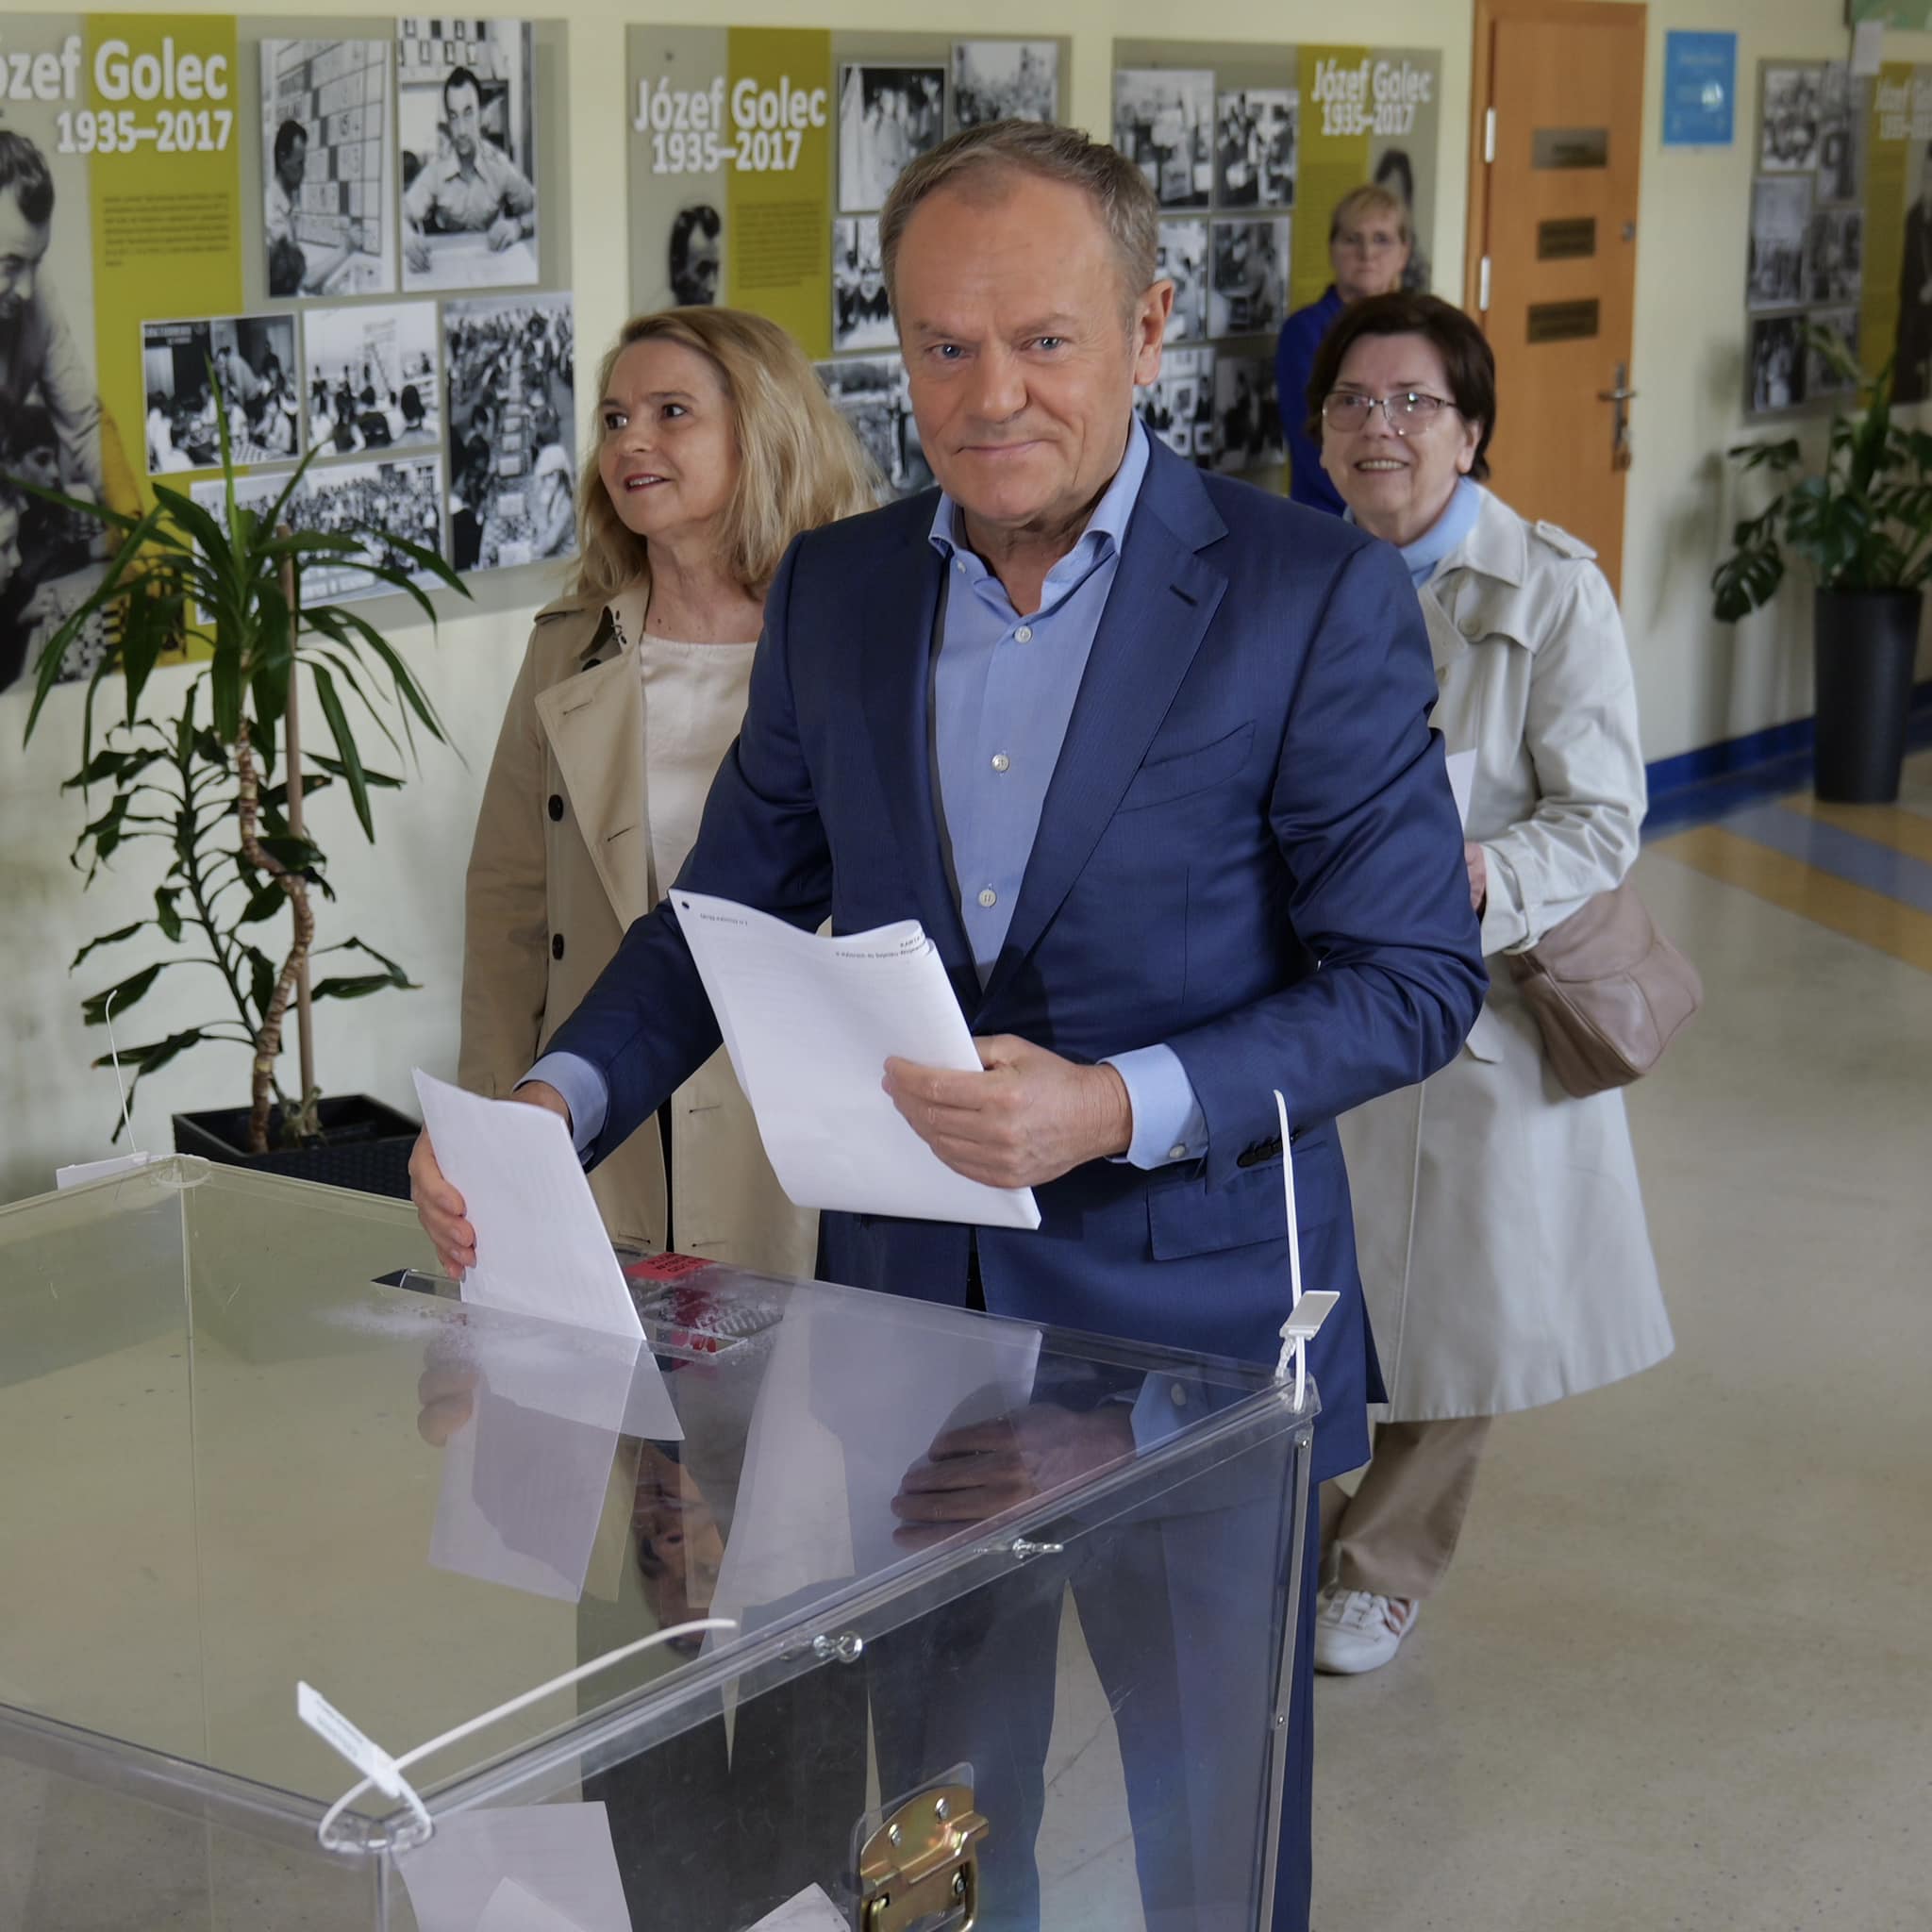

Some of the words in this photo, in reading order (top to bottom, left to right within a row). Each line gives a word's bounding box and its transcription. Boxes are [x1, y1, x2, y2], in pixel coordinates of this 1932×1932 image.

[94, 36, 228, 101] Golec
[633, 75, 725, 132] Józef
[730, 75, 827, 130] Golec
